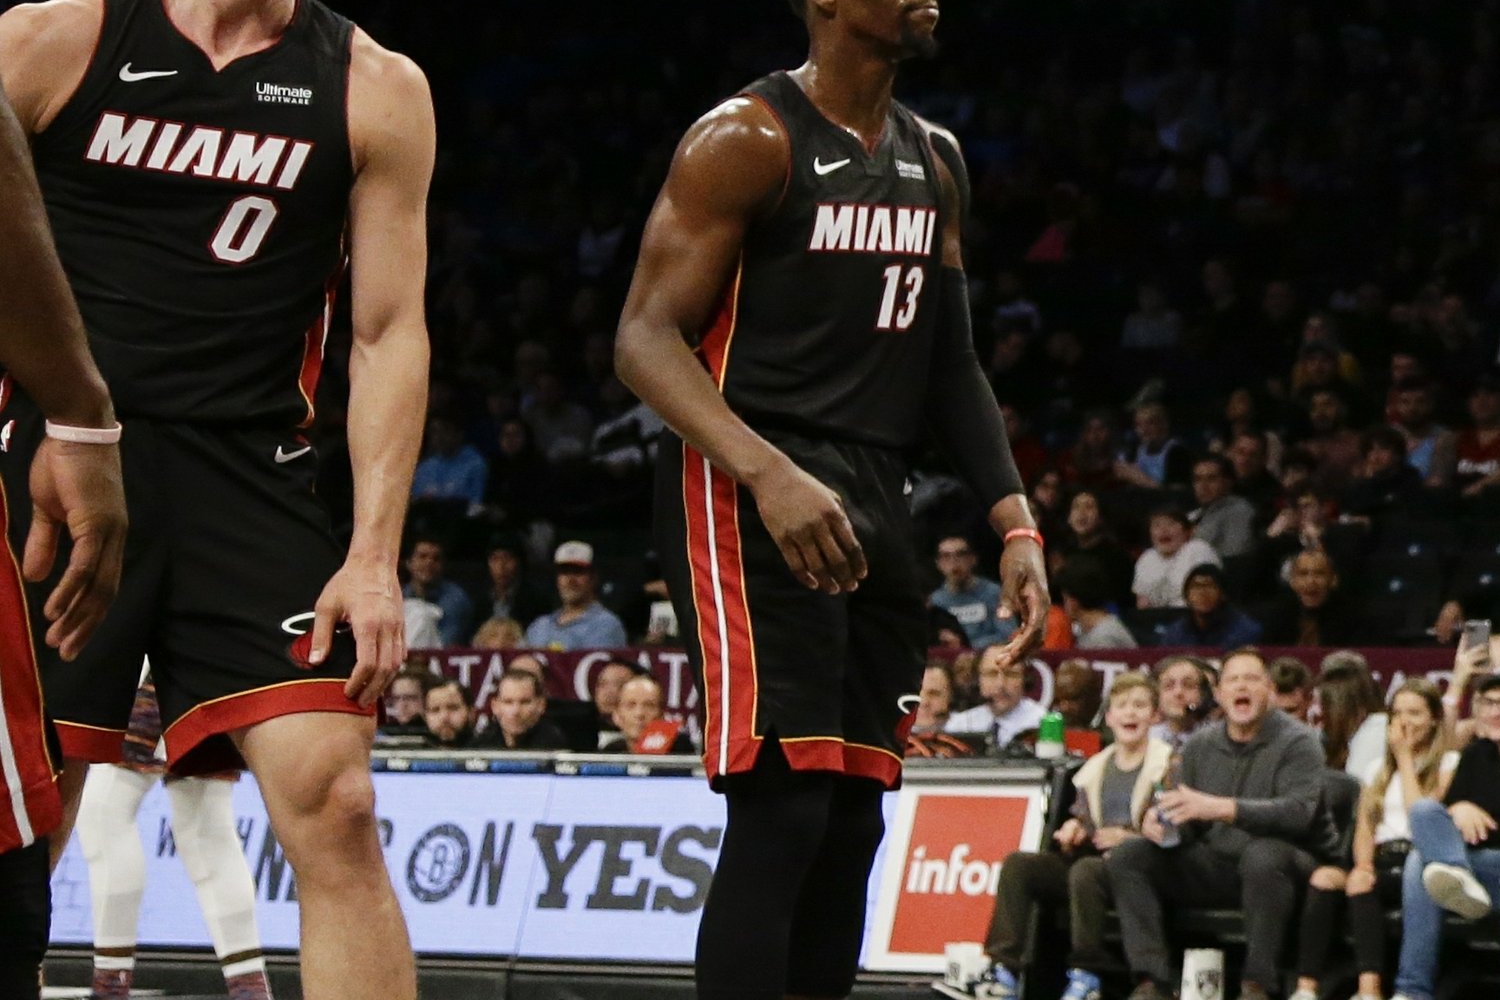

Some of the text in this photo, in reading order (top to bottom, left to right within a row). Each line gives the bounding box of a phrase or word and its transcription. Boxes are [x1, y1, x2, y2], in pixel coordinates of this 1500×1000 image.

[256, 81, 312, 99] Ultimate
[258, 94, 309, 105] SOFTWARE
[84, 111, 315, 191] MIAMI
[209, 195, 278, 265] 0
[808, 203, 937, 256] MIAMI
[875, 264, 925, 331] 13
[531, 822, 725, 914] YES
